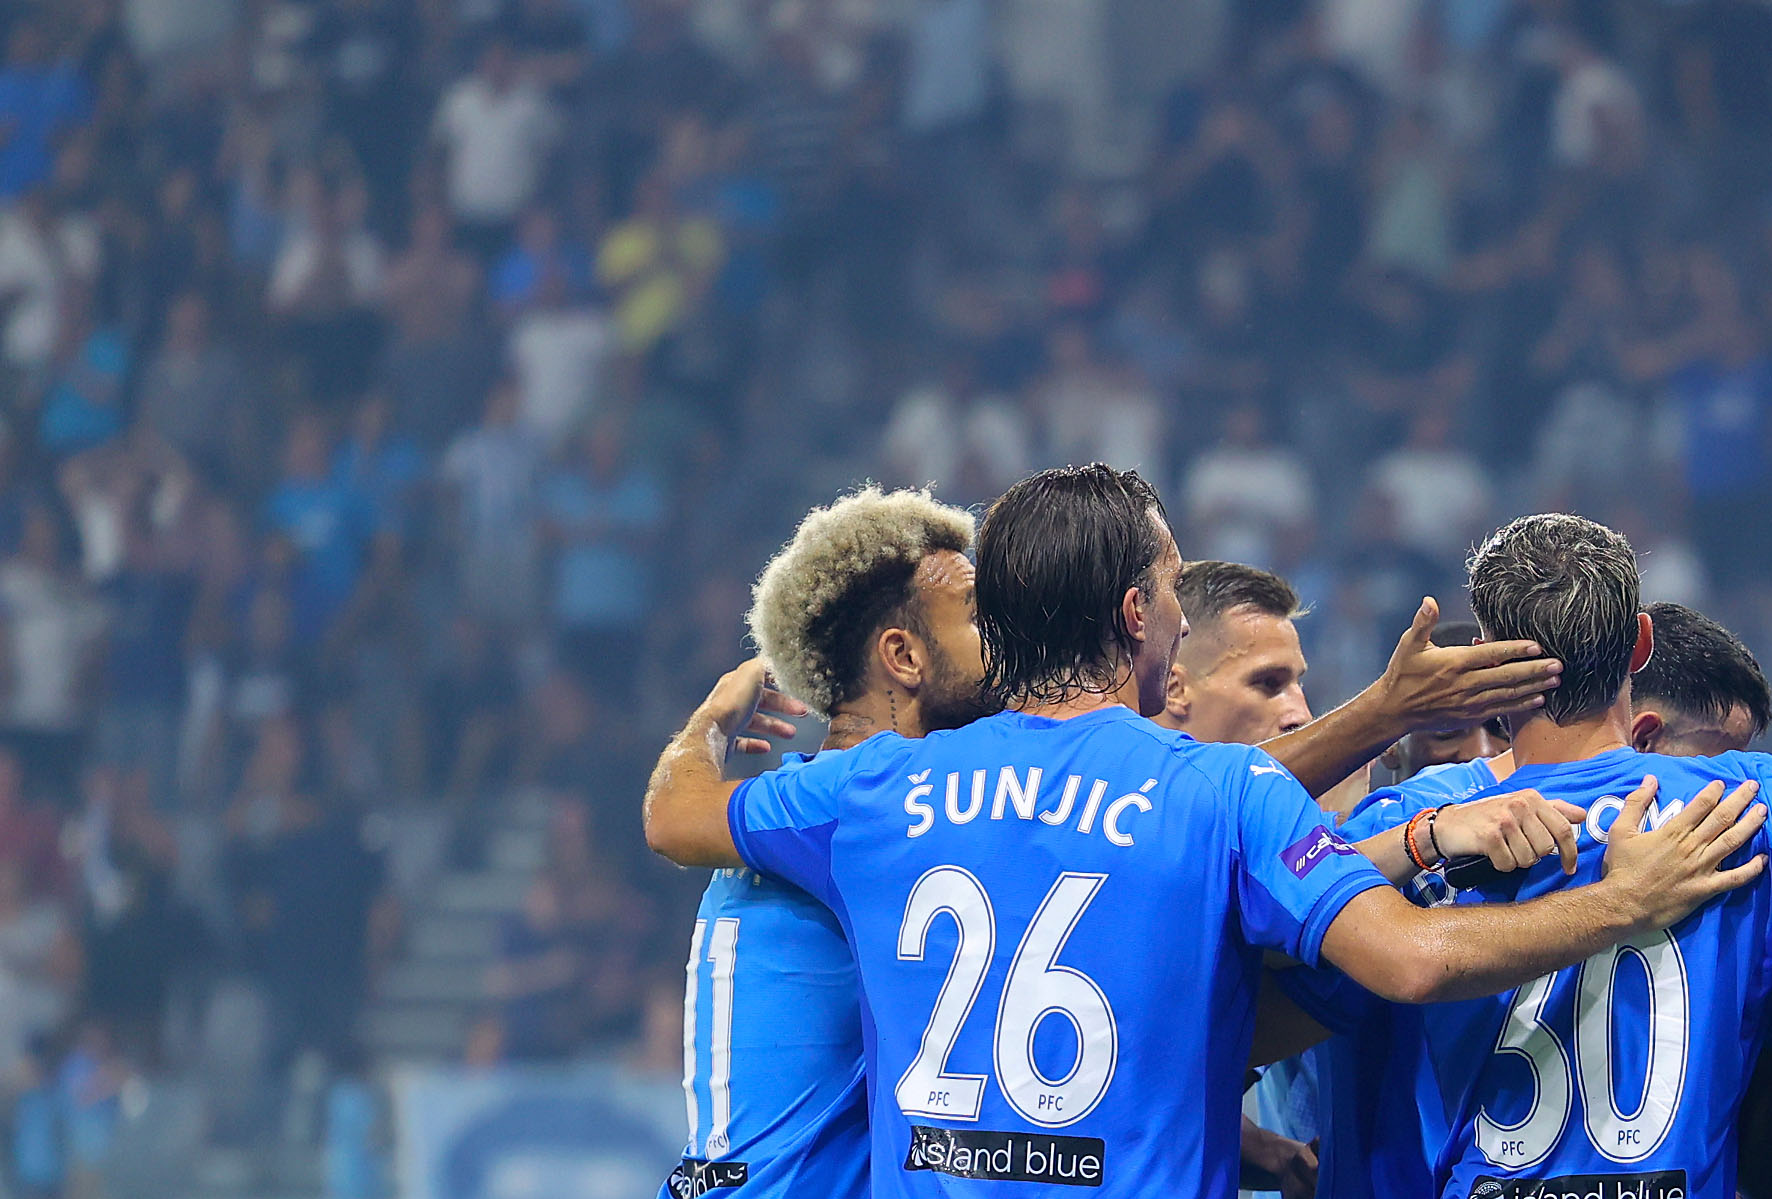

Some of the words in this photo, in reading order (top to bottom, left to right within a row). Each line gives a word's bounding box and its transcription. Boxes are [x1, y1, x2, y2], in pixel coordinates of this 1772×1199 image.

[904, 766, 1159, 847] ŠUNJIĆ
[896, 864, 1118, 1127] 26
[683, 917, 740, 1160] 11
[1475, 928, 1689, 1171] 30
[927, 1091, 950, 1107] PFC
[1038, 1094, 1064, 1111] PFC
[921, 1134, 1013, 1173] island
[1026, 1141, 1100, 1179] blue
[1501, 1140, 1525, 1157] PFC
[1617, 1128, 1640, 1146] PFC
